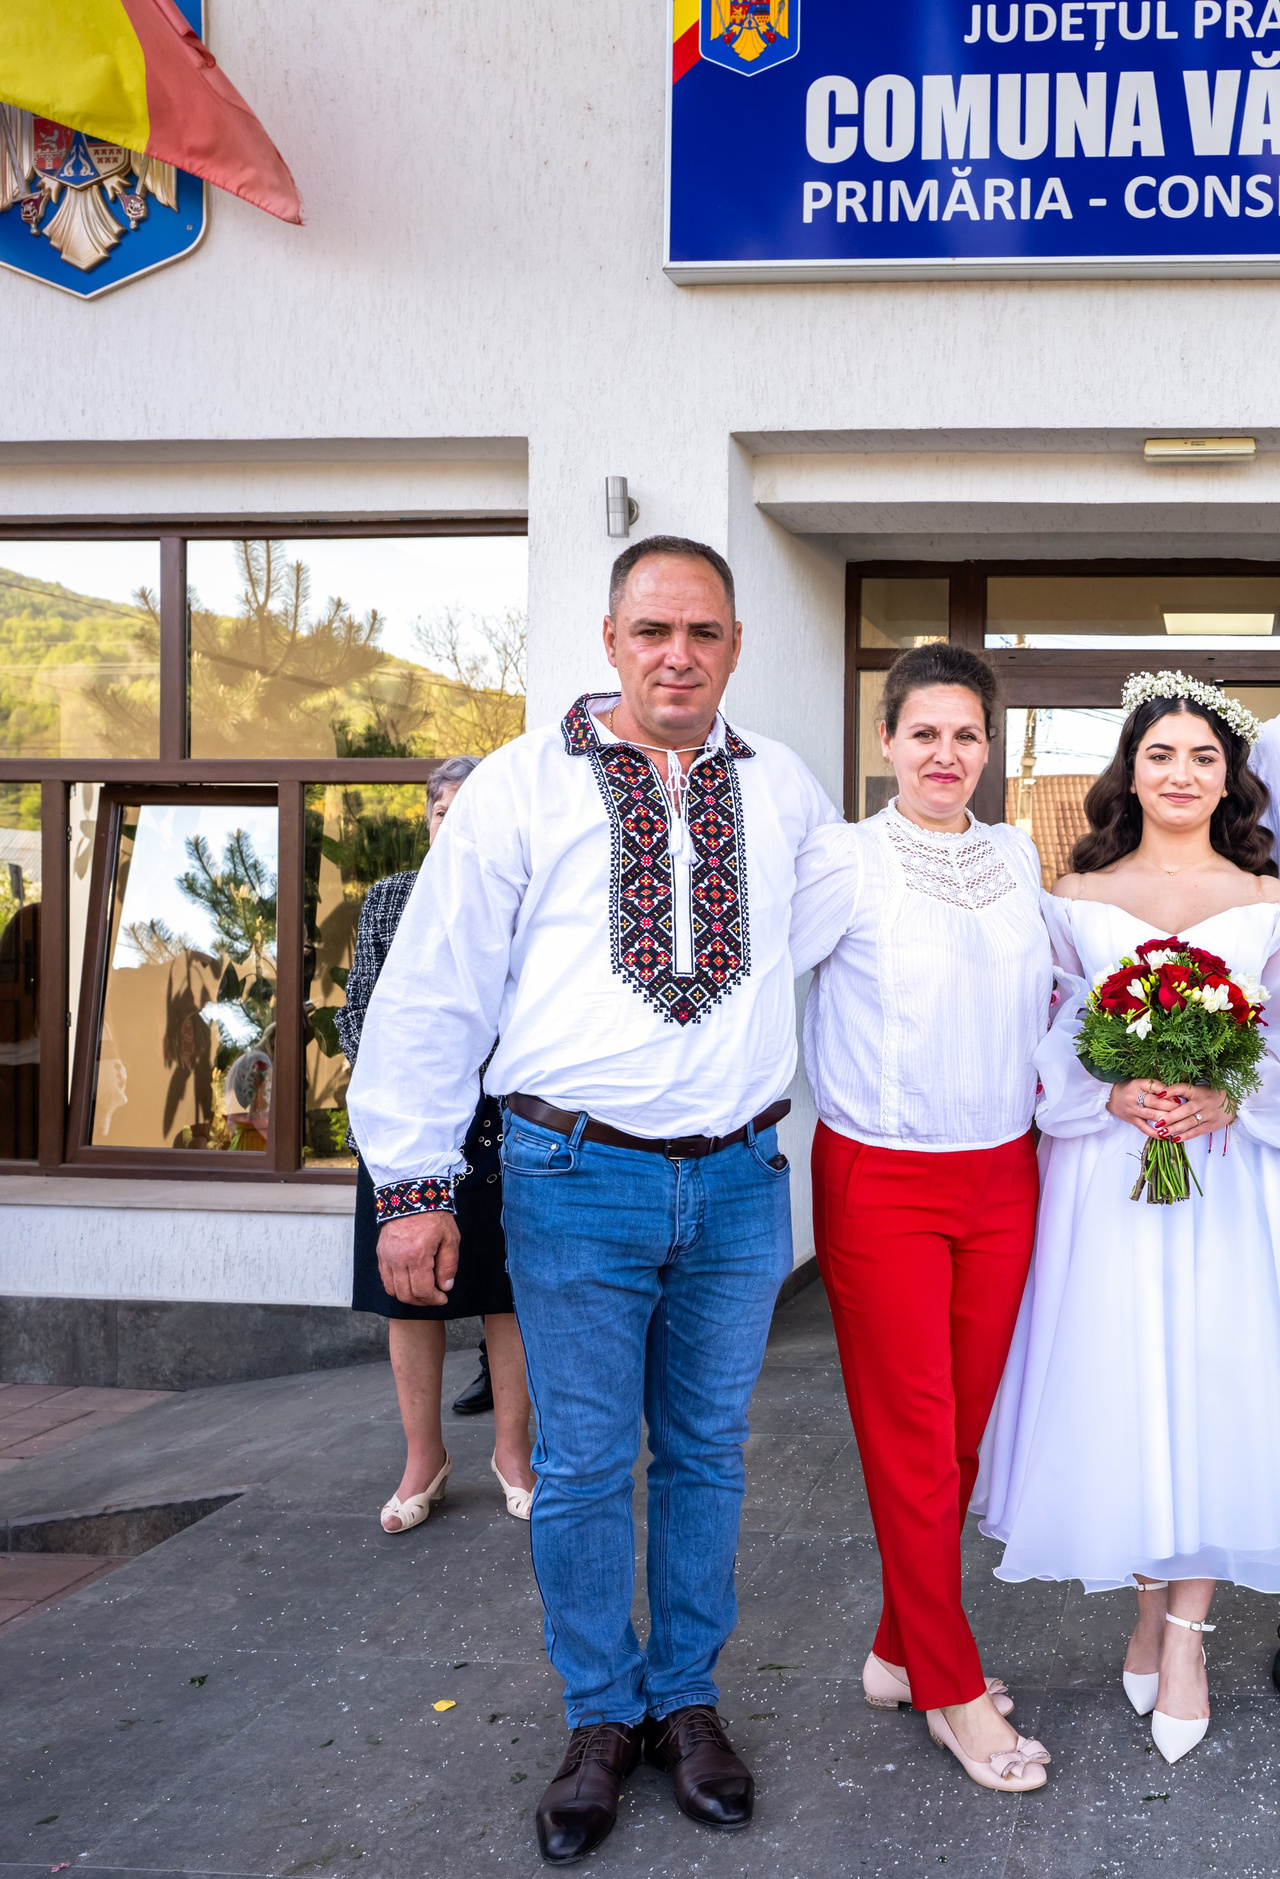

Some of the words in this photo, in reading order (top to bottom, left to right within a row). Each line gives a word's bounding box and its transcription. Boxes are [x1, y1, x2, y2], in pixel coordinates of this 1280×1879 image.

[963, 0, 1179, 51] JUDEȚUL
[805, 70, 1166, 164] COMUNA
[802, 166, 1073, 224] PRIMĂRIA
